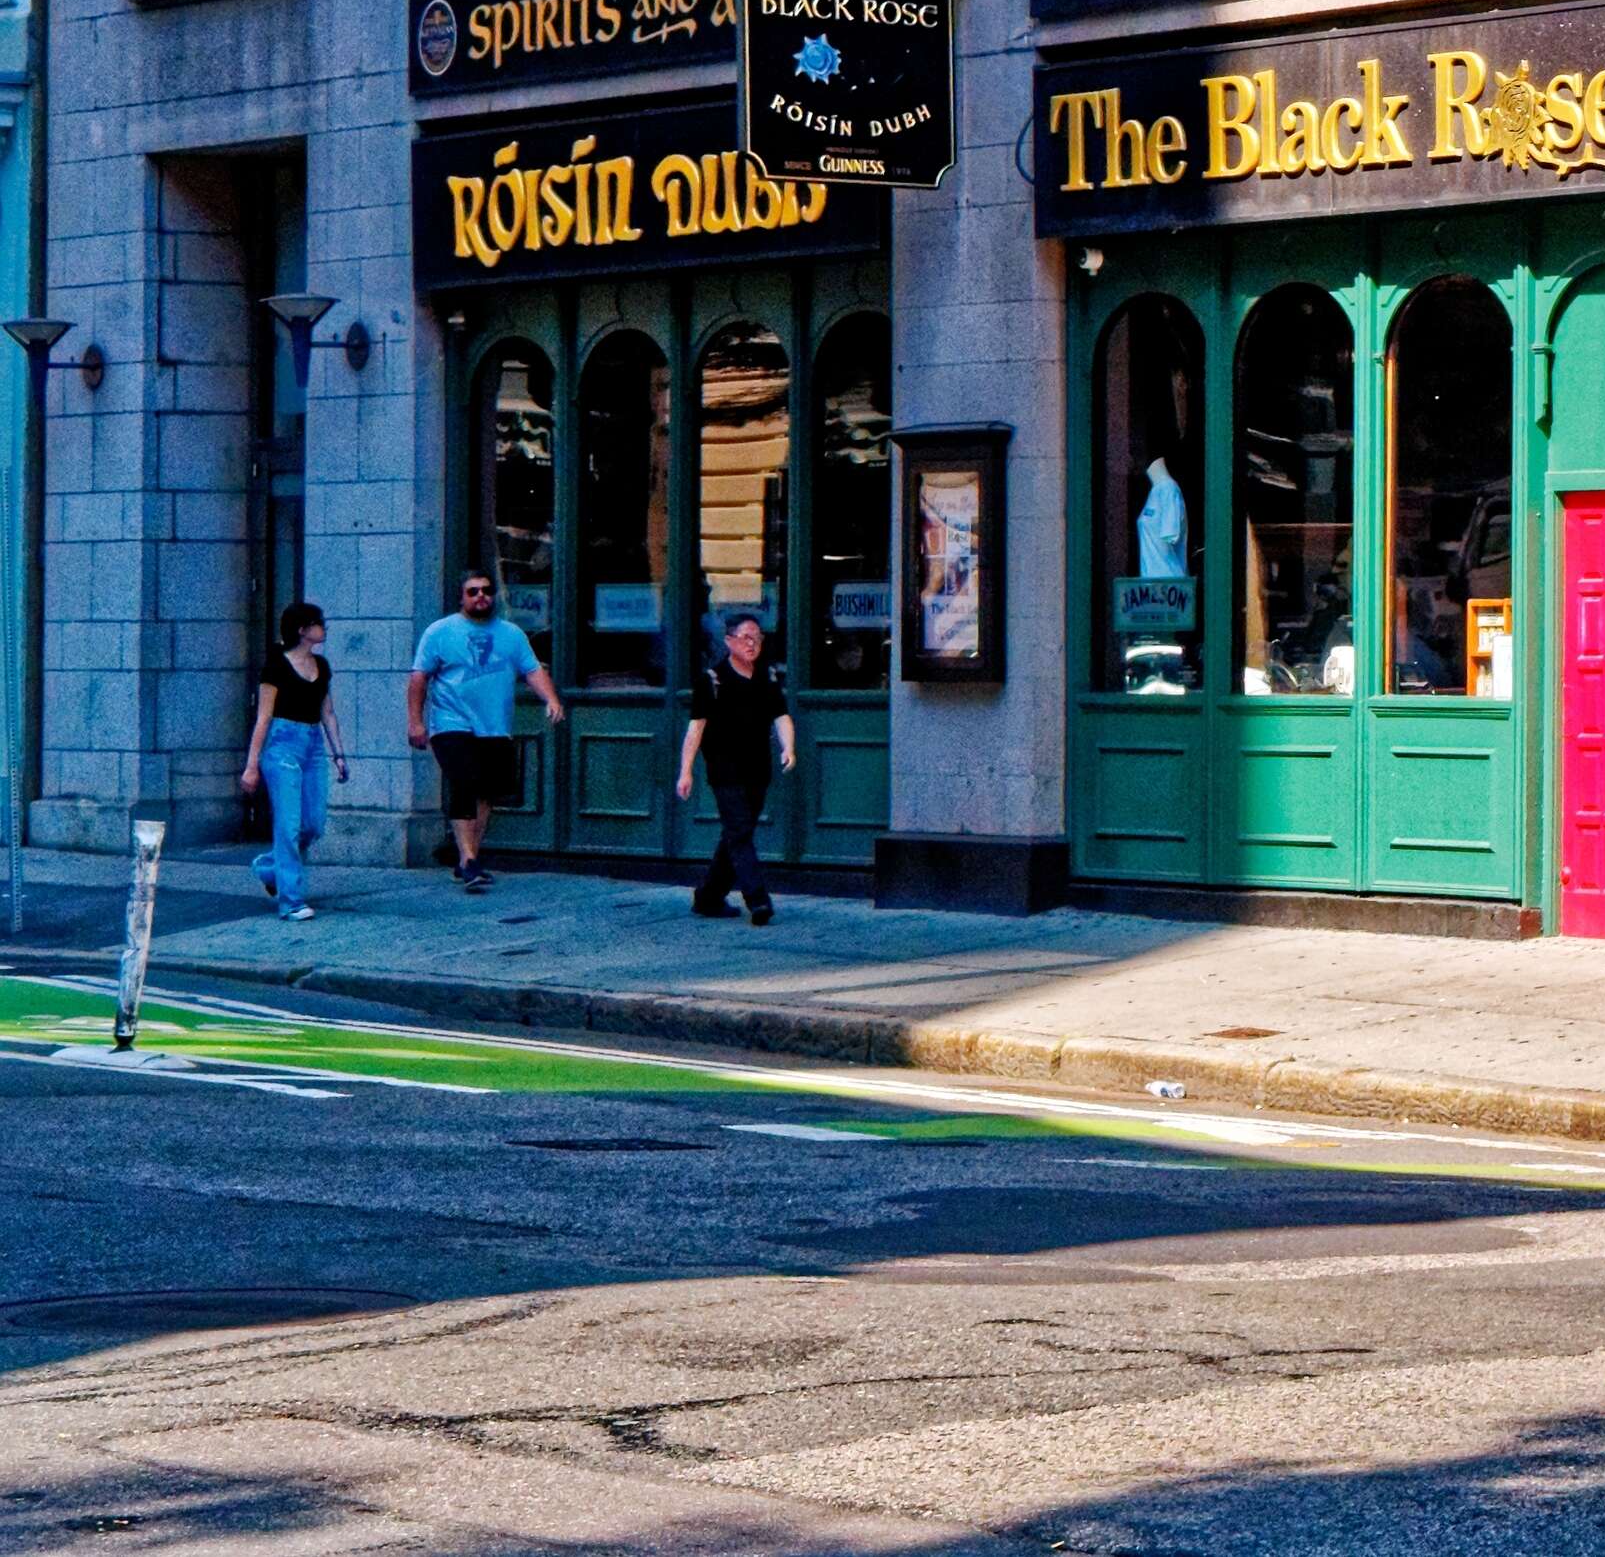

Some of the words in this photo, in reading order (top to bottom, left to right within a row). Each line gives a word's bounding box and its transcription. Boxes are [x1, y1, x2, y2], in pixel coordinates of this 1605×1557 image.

[863, 0, 938, 28] ROSE
[870, 104, 932, 137] DUBH
[1050, 88, 1187, 192] The
[1200, 58, 1412, 180] Black
[819, 154, 885, 176] GUINNESS
